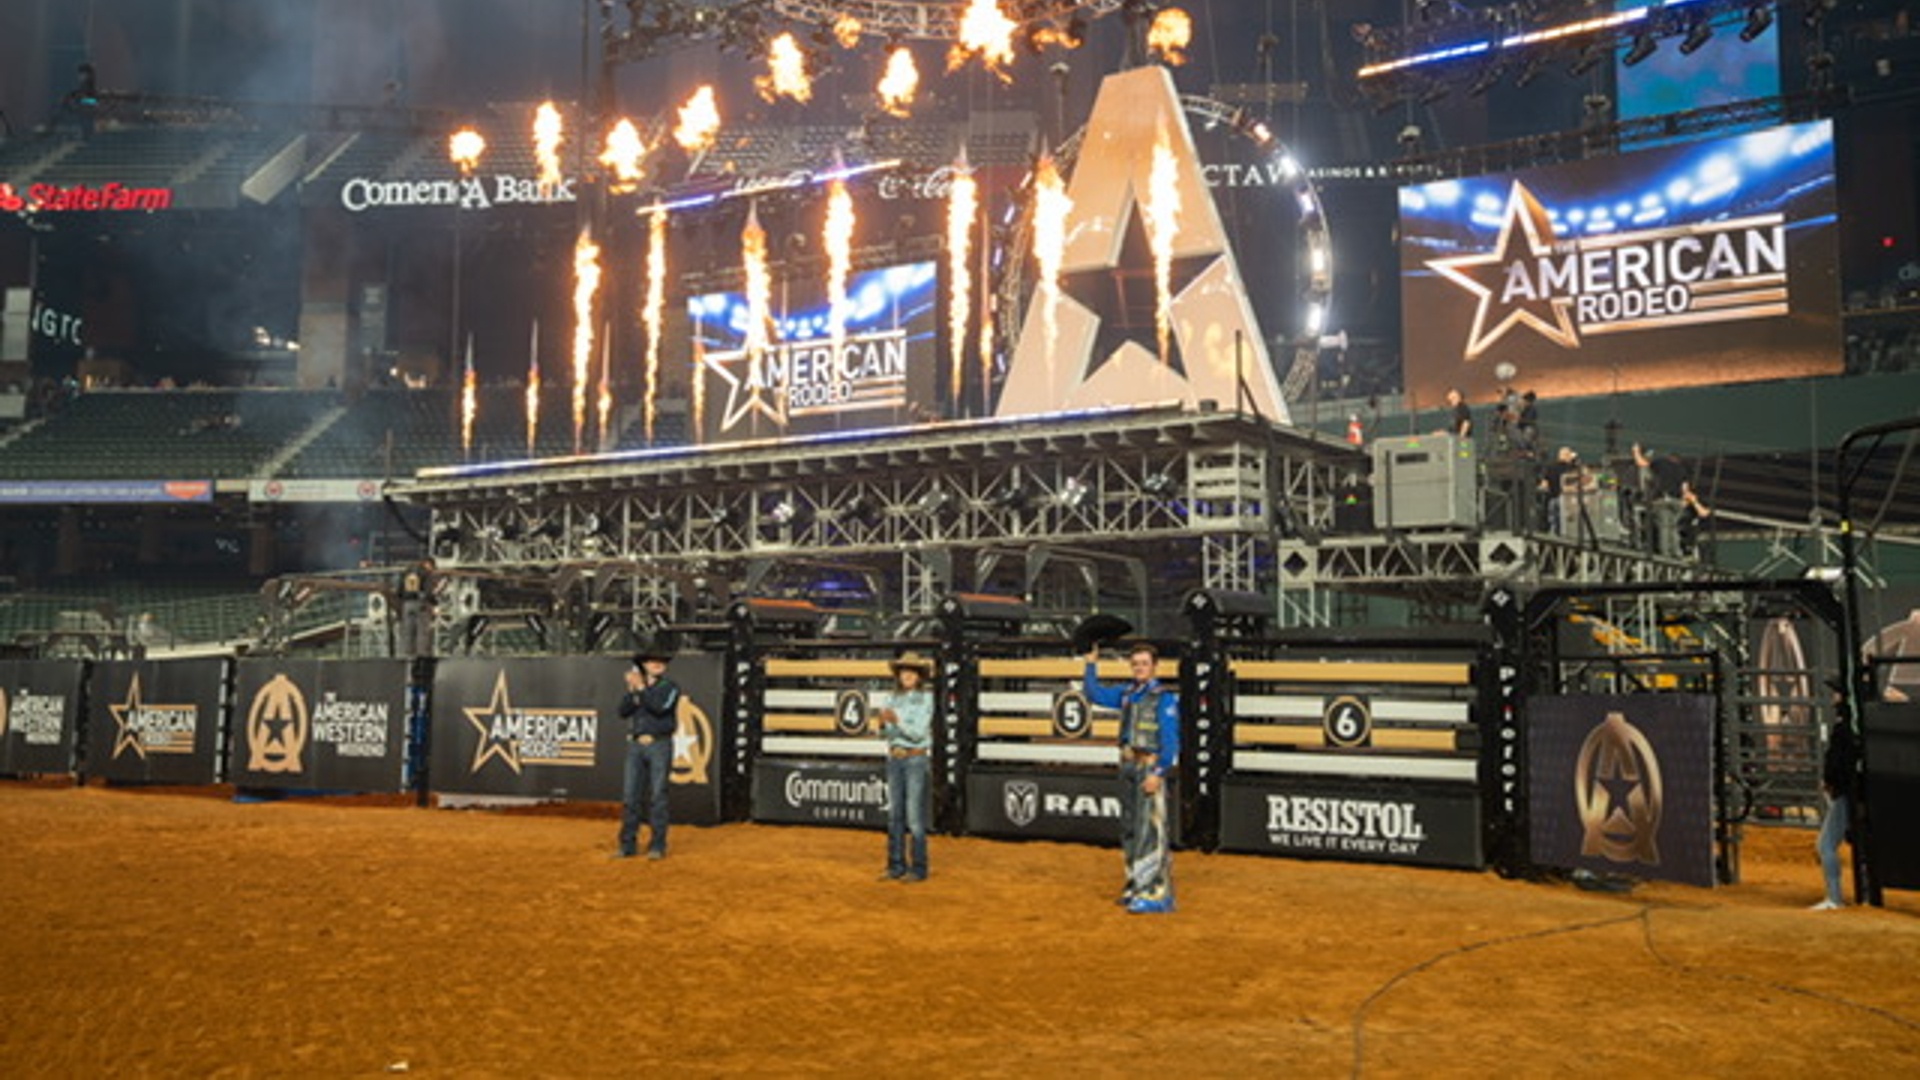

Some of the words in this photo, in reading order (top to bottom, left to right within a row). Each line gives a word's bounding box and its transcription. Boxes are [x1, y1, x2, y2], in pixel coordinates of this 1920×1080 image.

[1502, 226, 1786, 304] AMERICAN
[1578, 285, 1688, 322] RODEO
[789, 380, 851, 406] RODEO
[124, 709, 197, 733] AMERICAN
[313, 702, 388, 721] AMERICAN
[843, 698, 859, 725] 4
[1063, 701, 1081, 730] 5
[1336, 707, 1357, 738] 6
[313, 722, 388, 742] WESTERN
[490, 713, 598, 742] AMERICAN
[785, 771, 892, 811] Community
[1266, 794, 1424, 841] RESISTOL
[1268, 833, 1291, 847] WE
[1293, 834, 1323, 848] LIVE
[1326, 836, 1339, 849] IT
[1340, 838, 1386, 853] EVERY
[1388, 840, 1420, 855] DAY
